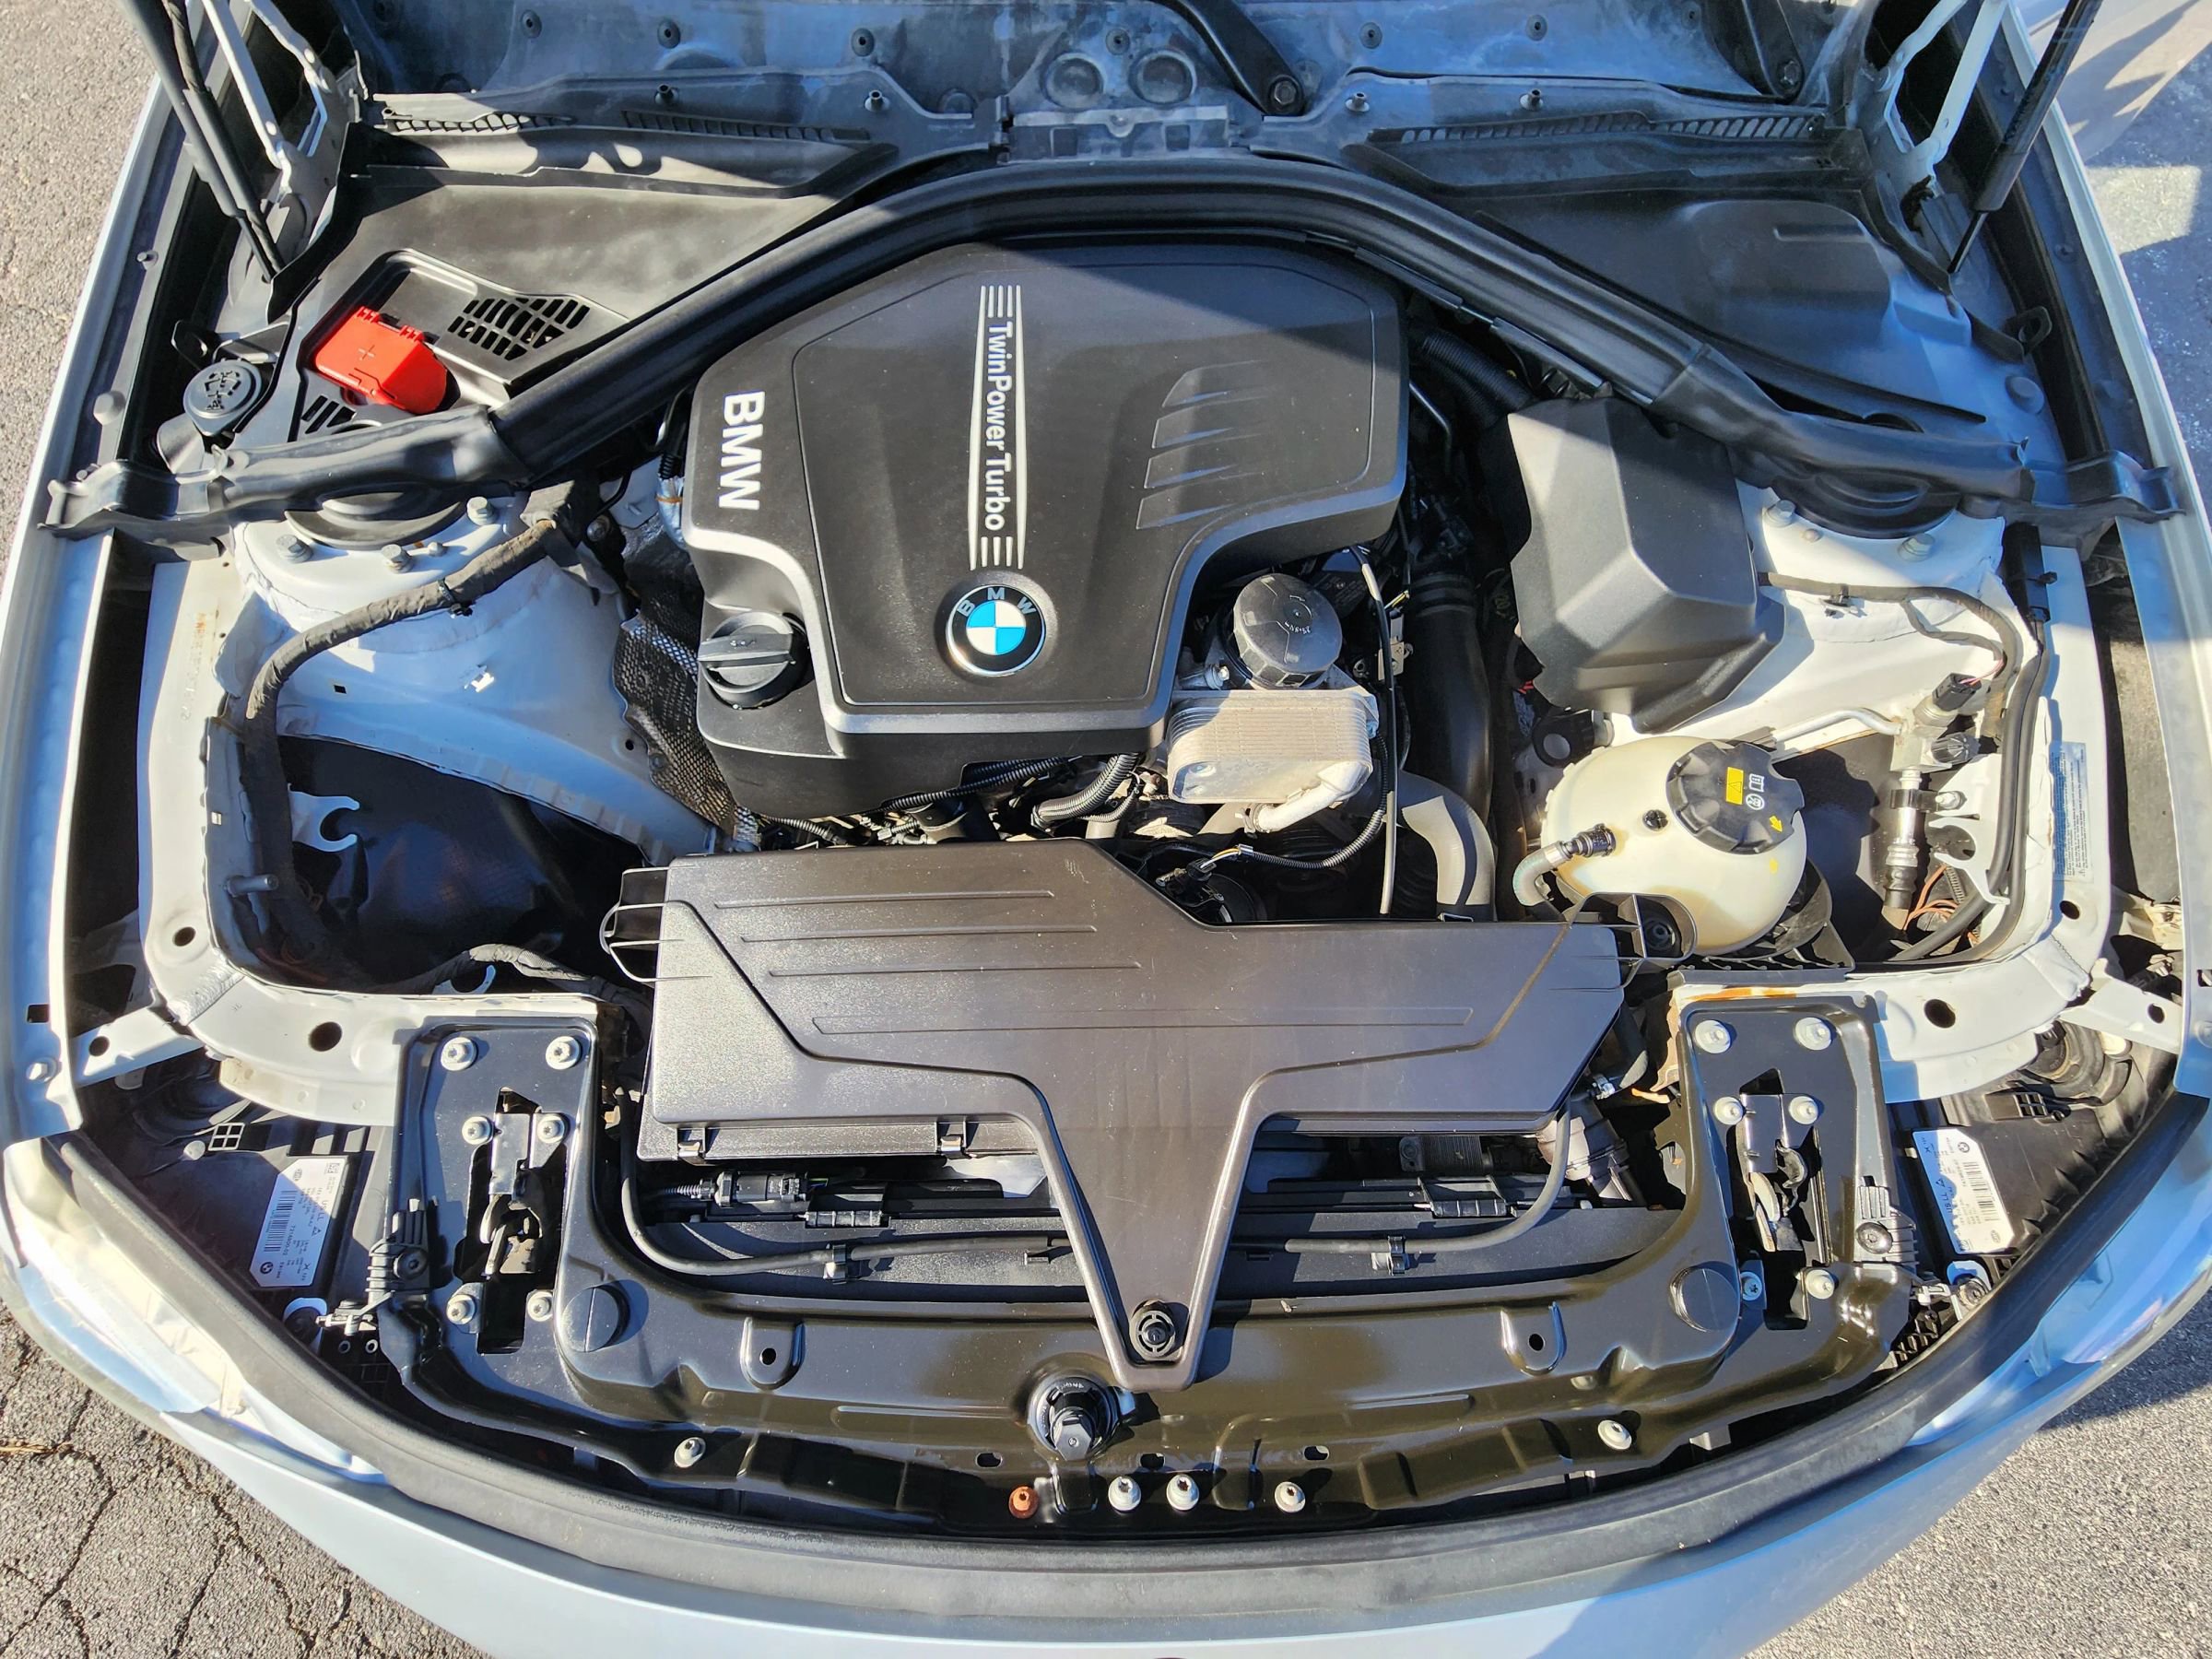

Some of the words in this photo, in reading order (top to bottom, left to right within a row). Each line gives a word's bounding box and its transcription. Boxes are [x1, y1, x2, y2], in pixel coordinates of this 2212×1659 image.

[985, 320, 1014, 451] TwinPower
[718, 390, 766, 512] BMW
[983, 453, 1014, 532] Turbo
